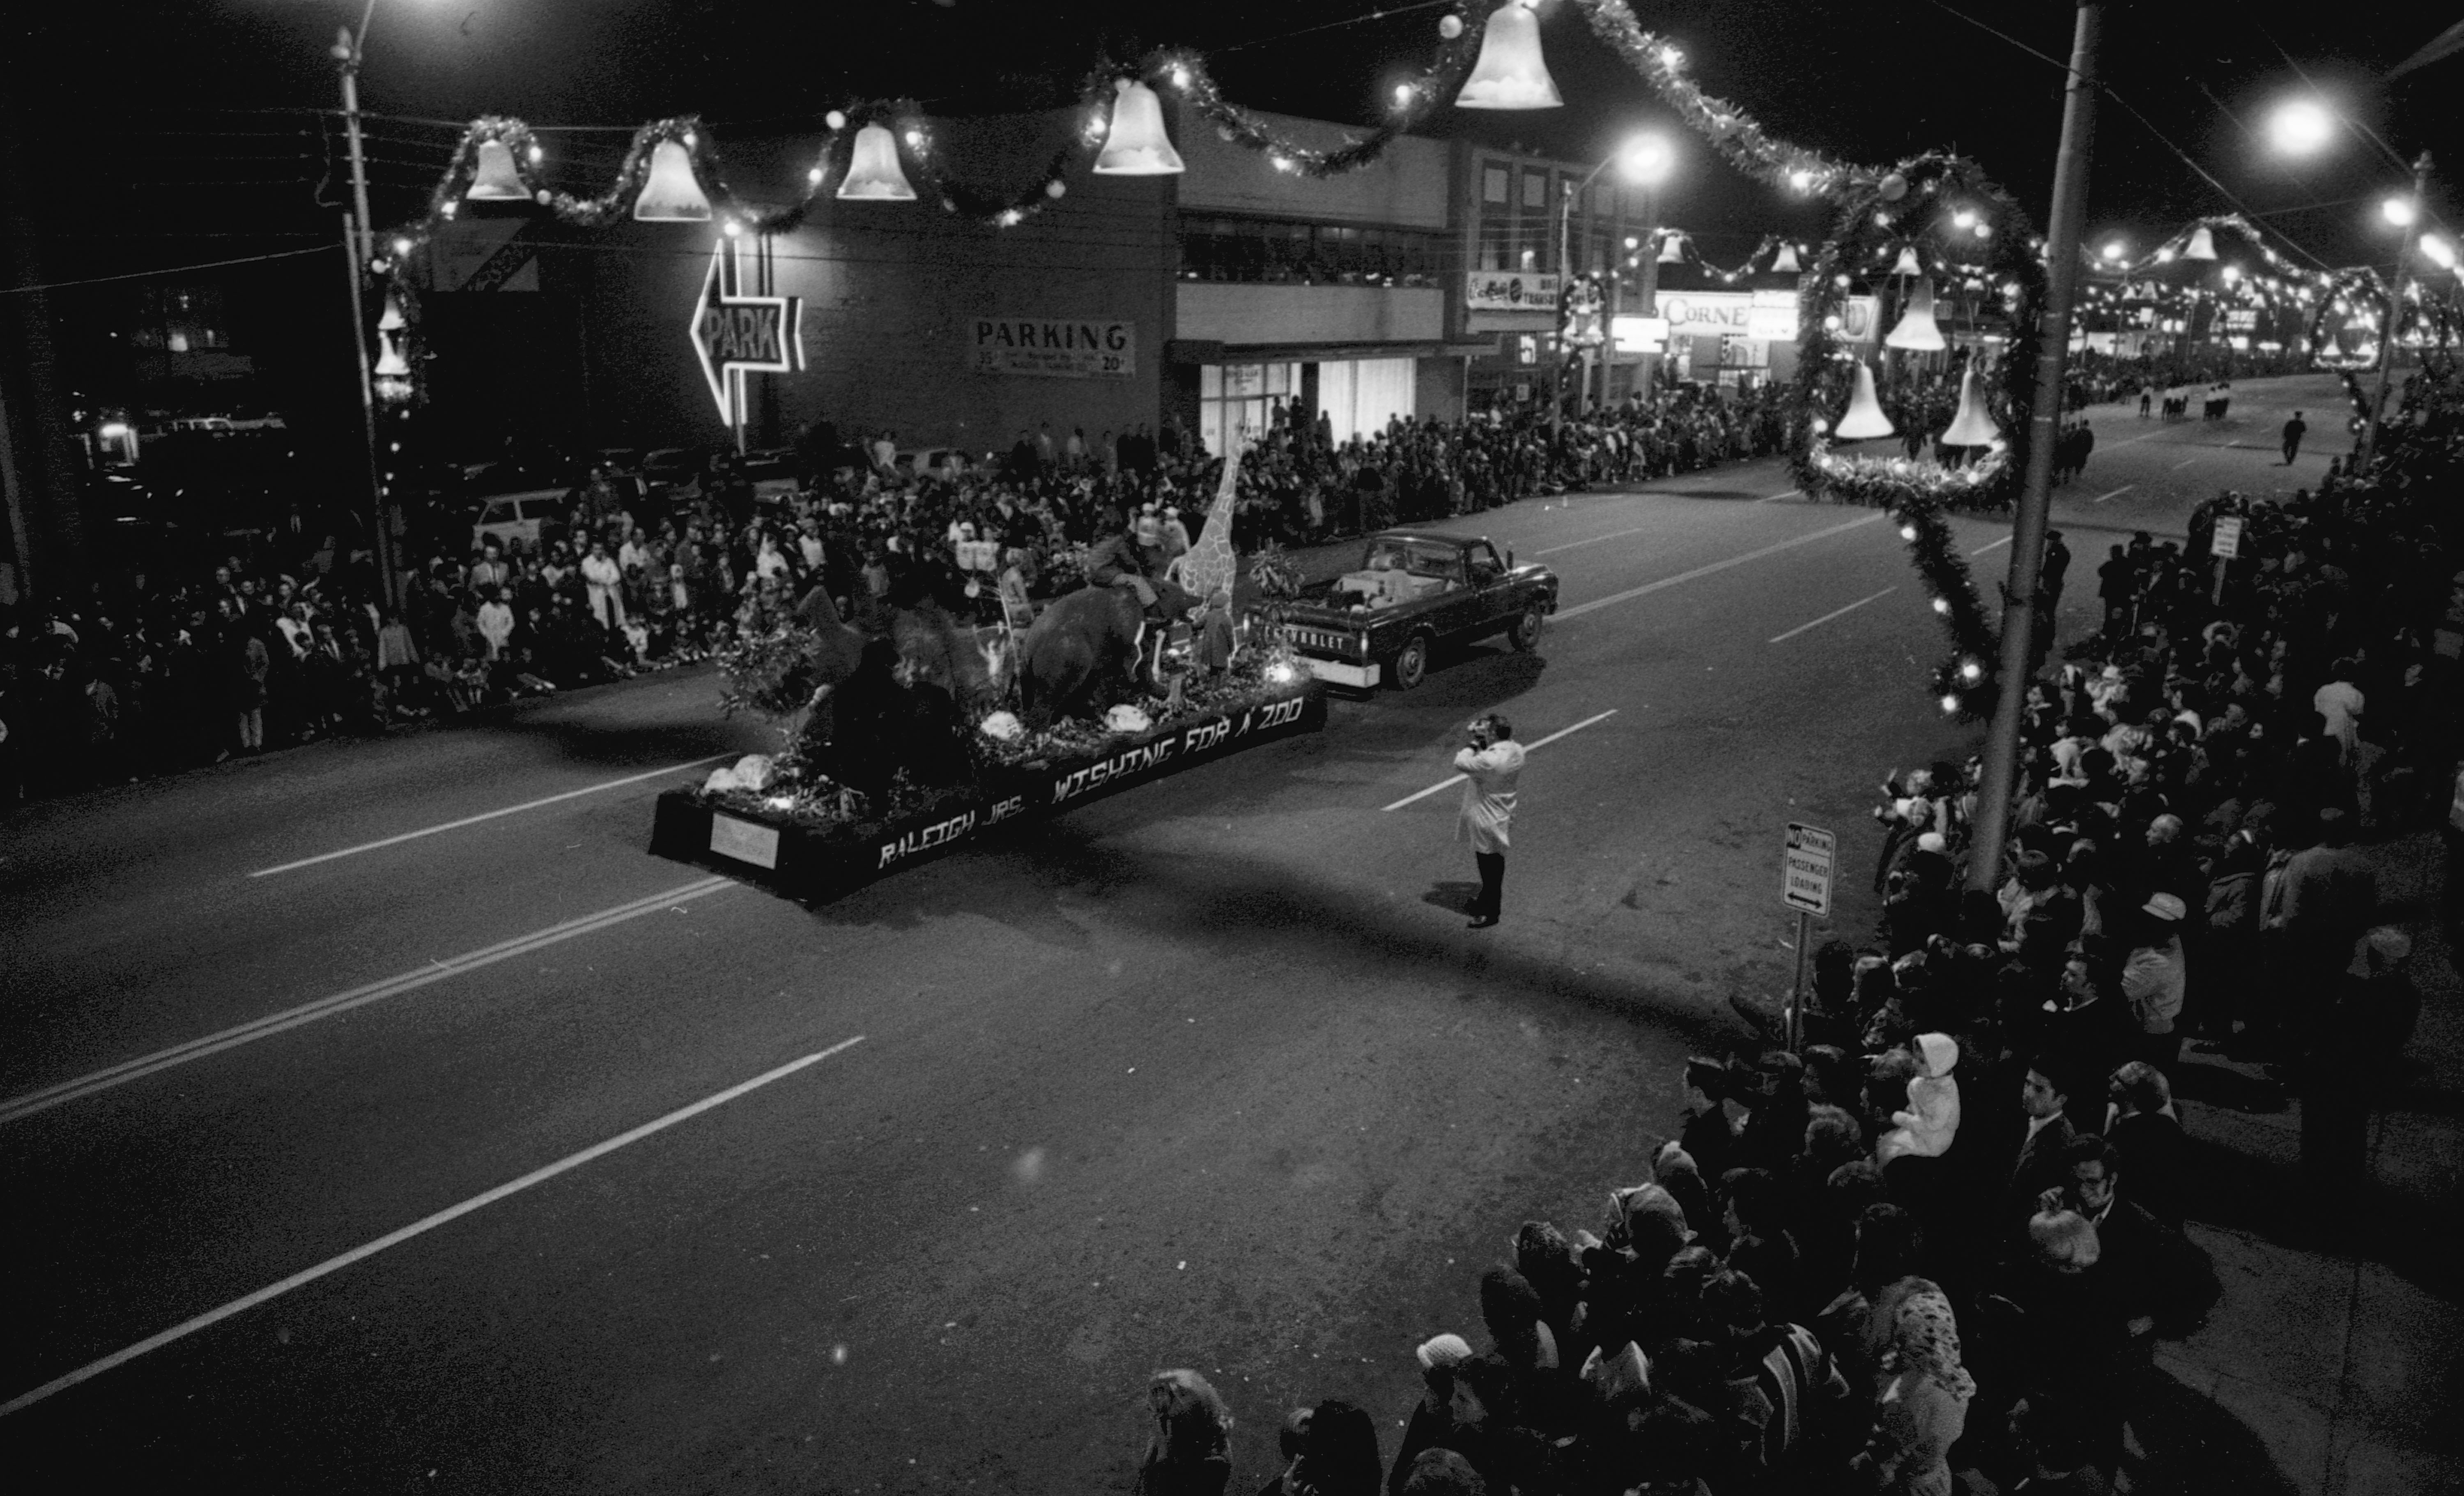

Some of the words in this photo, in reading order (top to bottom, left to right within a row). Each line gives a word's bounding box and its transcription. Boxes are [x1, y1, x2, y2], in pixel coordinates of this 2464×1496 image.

[1663, 297, 1748, 326] CORNE
[706, 308, 777, 359] PARK
[977, 322, 1126, 350] PARKING
[878, 810, 975, 869] RALEIGH
[1051, 738, 1176, 804] WISHING
[1182, 718, 1231, 754] FOR
[1235, 712, 1251, 738] A
[1257, 697, 1303, 730] ZOO
[1787, 828, 1800, 845] NO
[1802, 834, 1831, 852] PARKING
[1788, 856, 1828, 878] PASSENGER
[1790, 876, 1823, 894] LOADING
